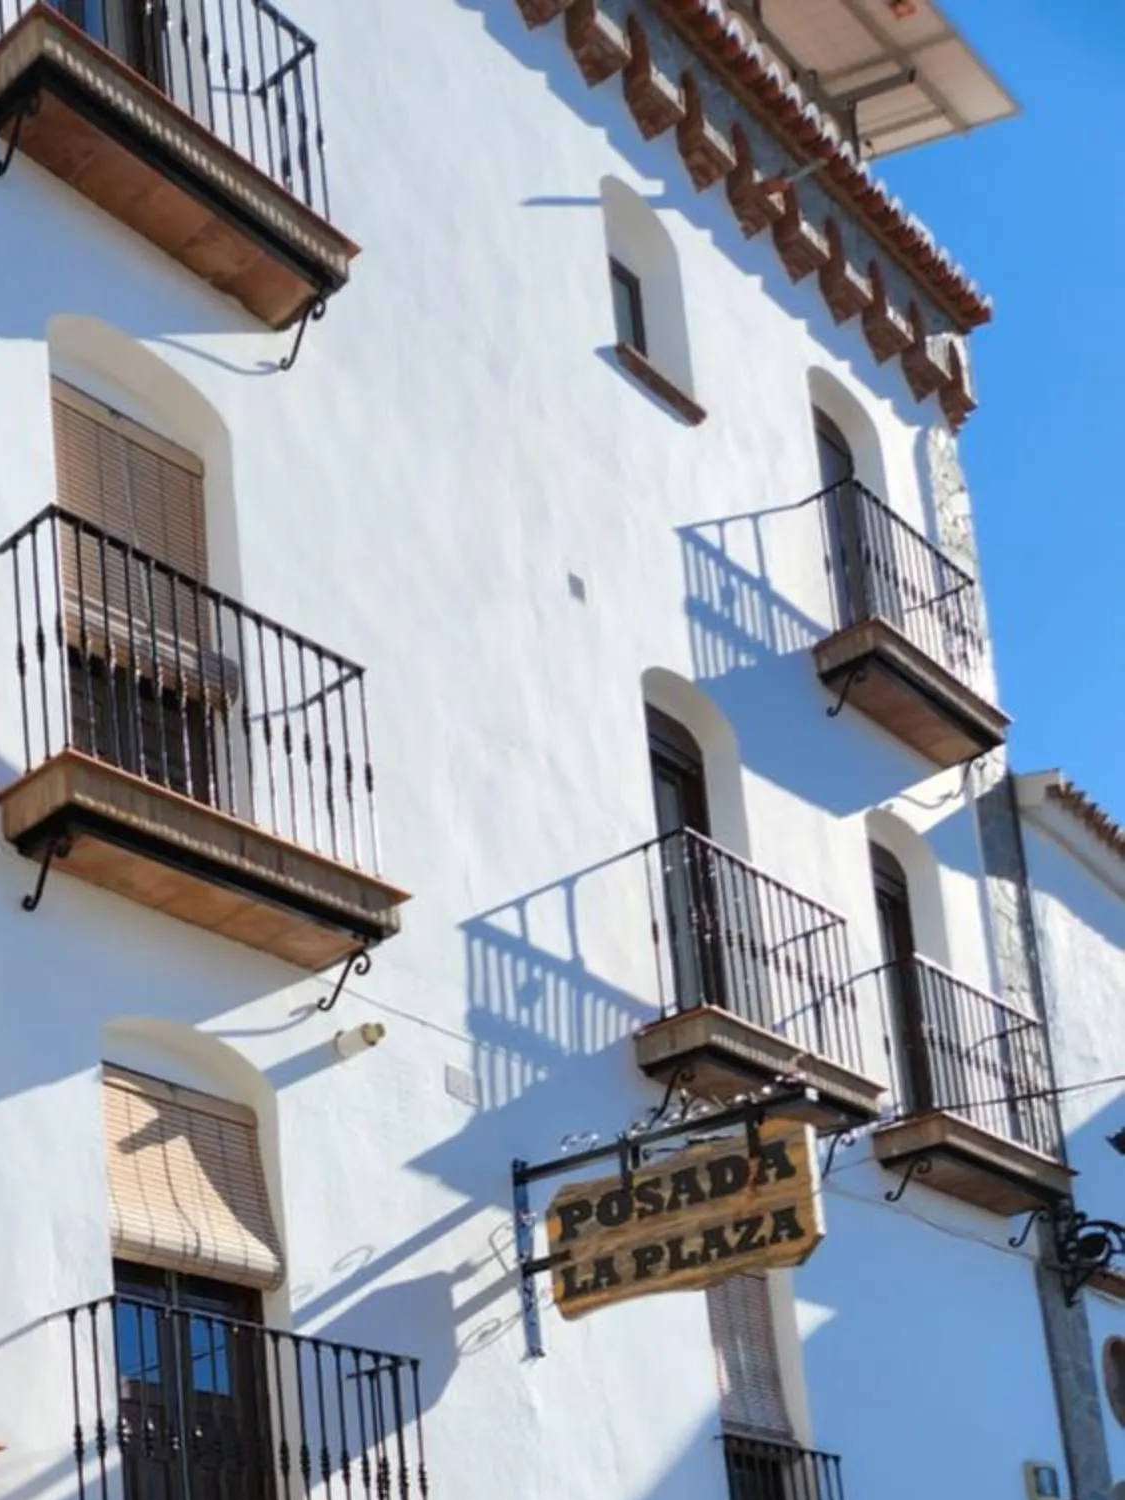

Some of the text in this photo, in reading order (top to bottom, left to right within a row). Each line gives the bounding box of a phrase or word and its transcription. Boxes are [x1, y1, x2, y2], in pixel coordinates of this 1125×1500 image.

[556, 1141, 797, 1242] POSADA
[560, 1206, 805, 1299] LA PLAZA
